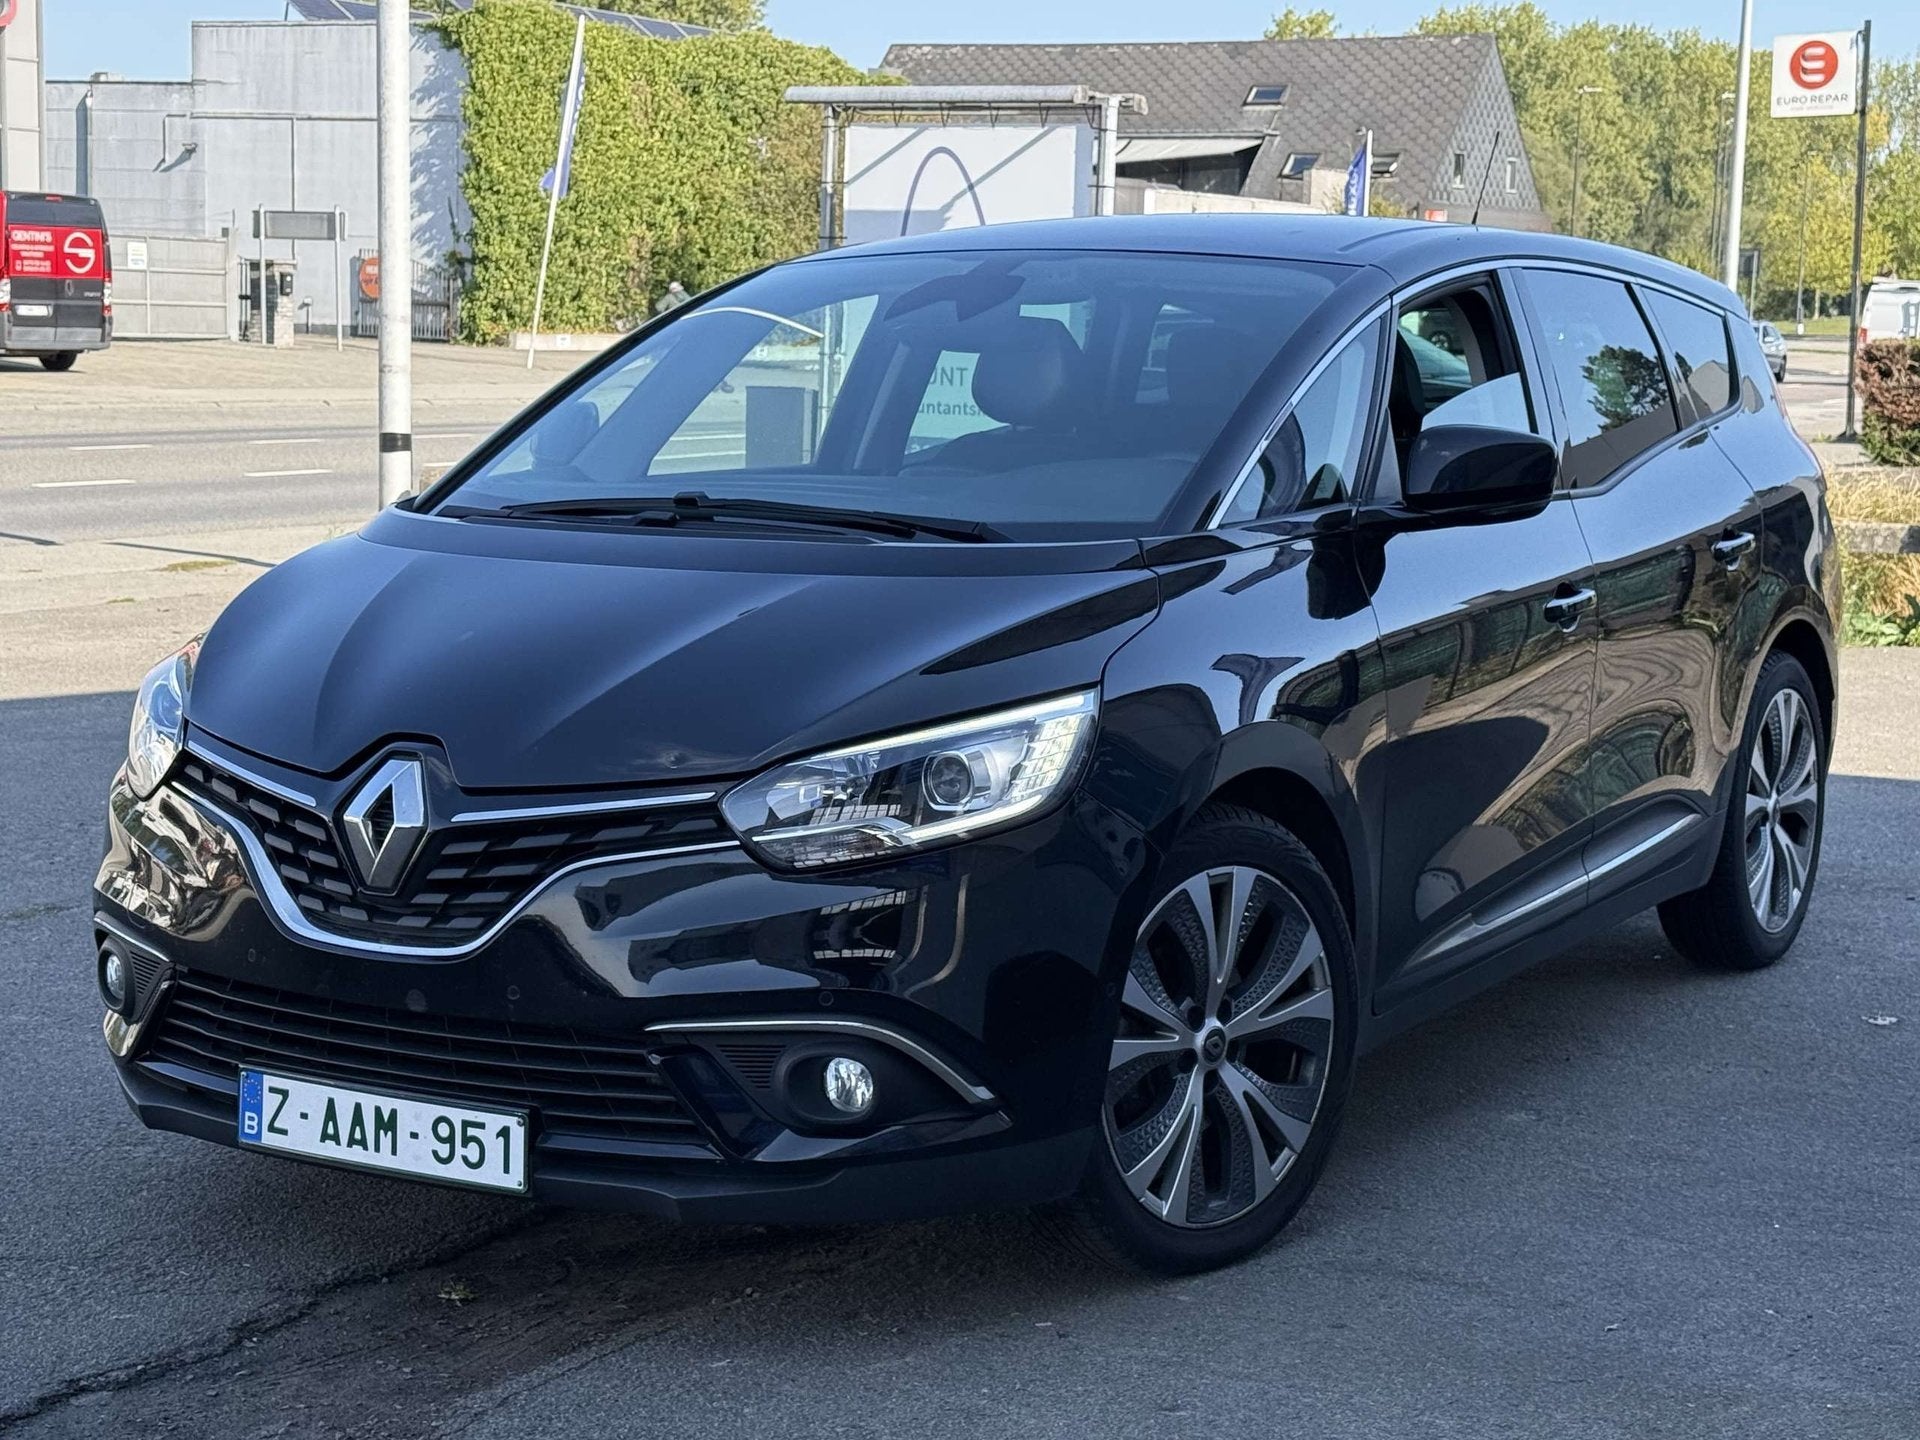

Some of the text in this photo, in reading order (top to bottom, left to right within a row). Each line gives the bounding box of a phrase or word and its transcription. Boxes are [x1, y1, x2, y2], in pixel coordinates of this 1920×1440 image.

[1776, 93, 1848, 106] EURO REPAR
[244, 1111, 258, 1134] B
[267, 1086, 511, 1174] Z-AAM-951
